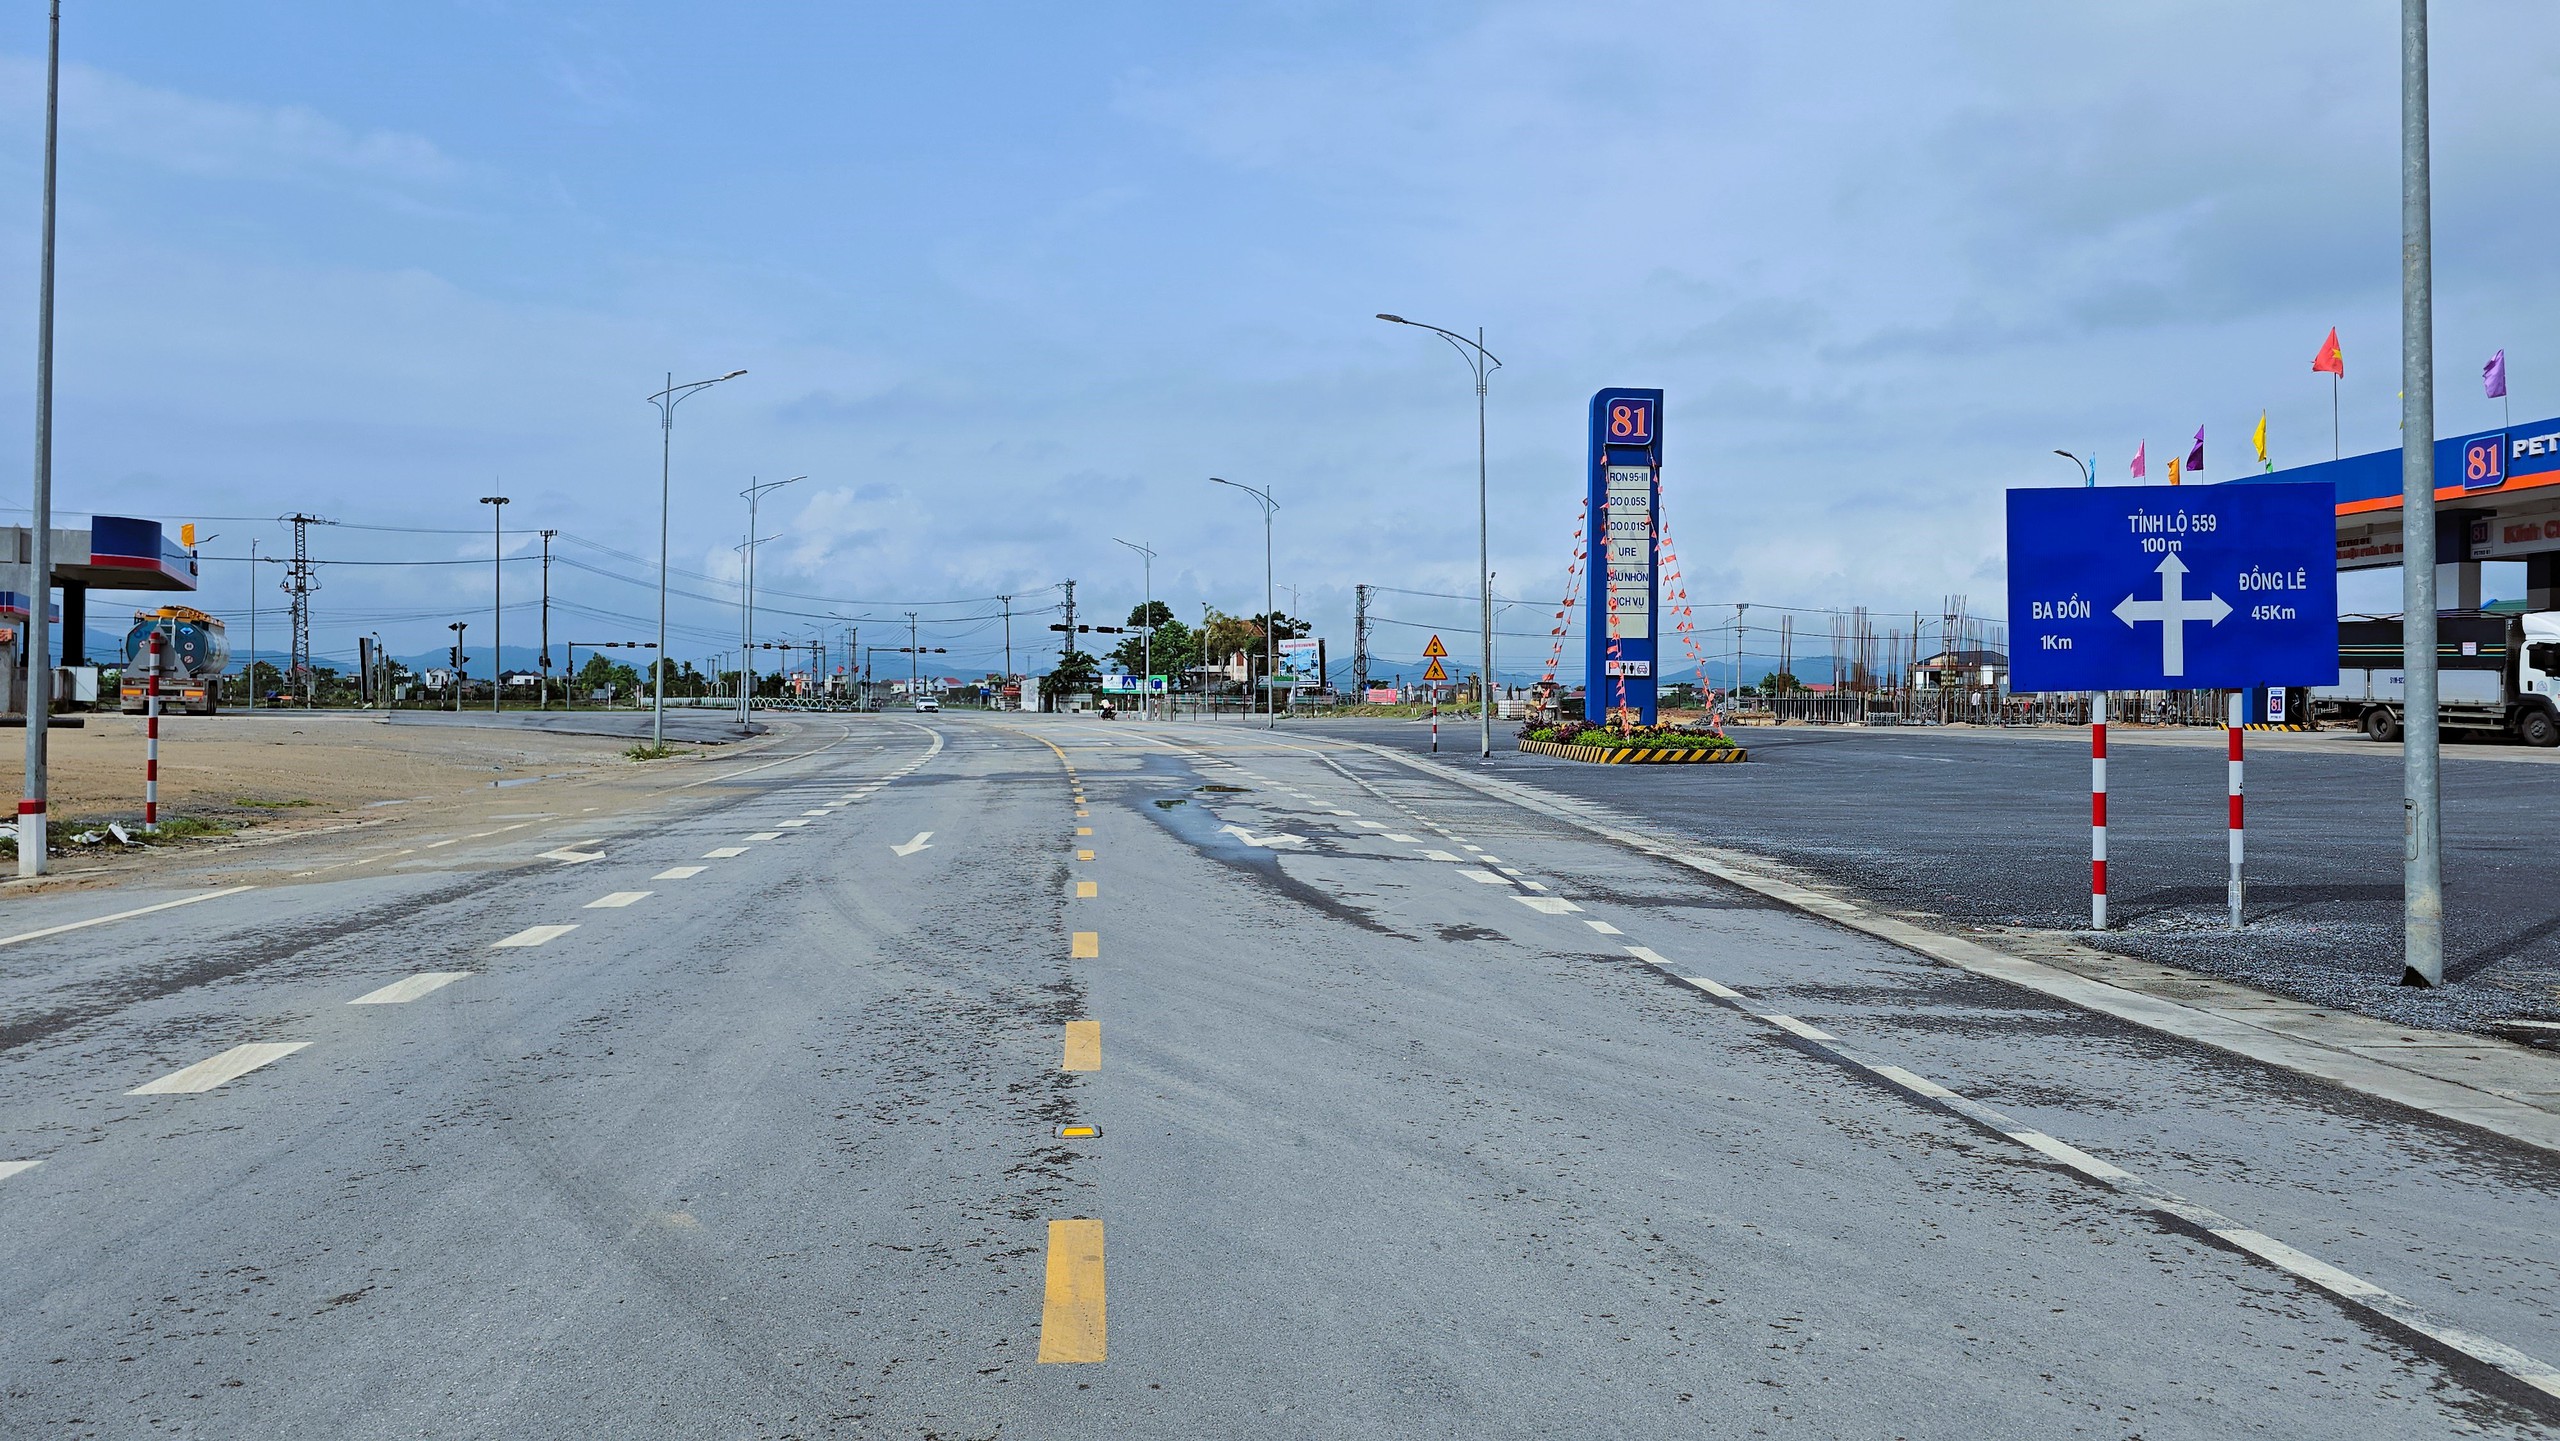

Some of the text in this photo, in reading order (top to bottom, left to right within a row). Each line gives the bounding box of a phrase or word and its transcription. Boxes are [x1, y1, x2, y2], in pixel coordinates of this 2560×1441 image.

[1612, 405, 1648, 437] 81
[2467, 443, 2500, 480] 81
[1609, 472, 1648, 482] RON 95-III
[1610, 496, 1647, 507] DO 0.05S
[1610, 521, 1646, 531] DO 0.01S
[2127, 508, 2217, 537] TỈNH LỘ 559
[1618, 547, 1637, 557] URE
[2141, 537, 2182, 553] 100 m
[2239, 564, 2307, 591] ĐỒNG LÊ
[2032, 592, 2091, 620] BA ĐỒN
[2251, 604, 2296, 620] 45Km
[2040, 634, 2073, 650] 1Km
